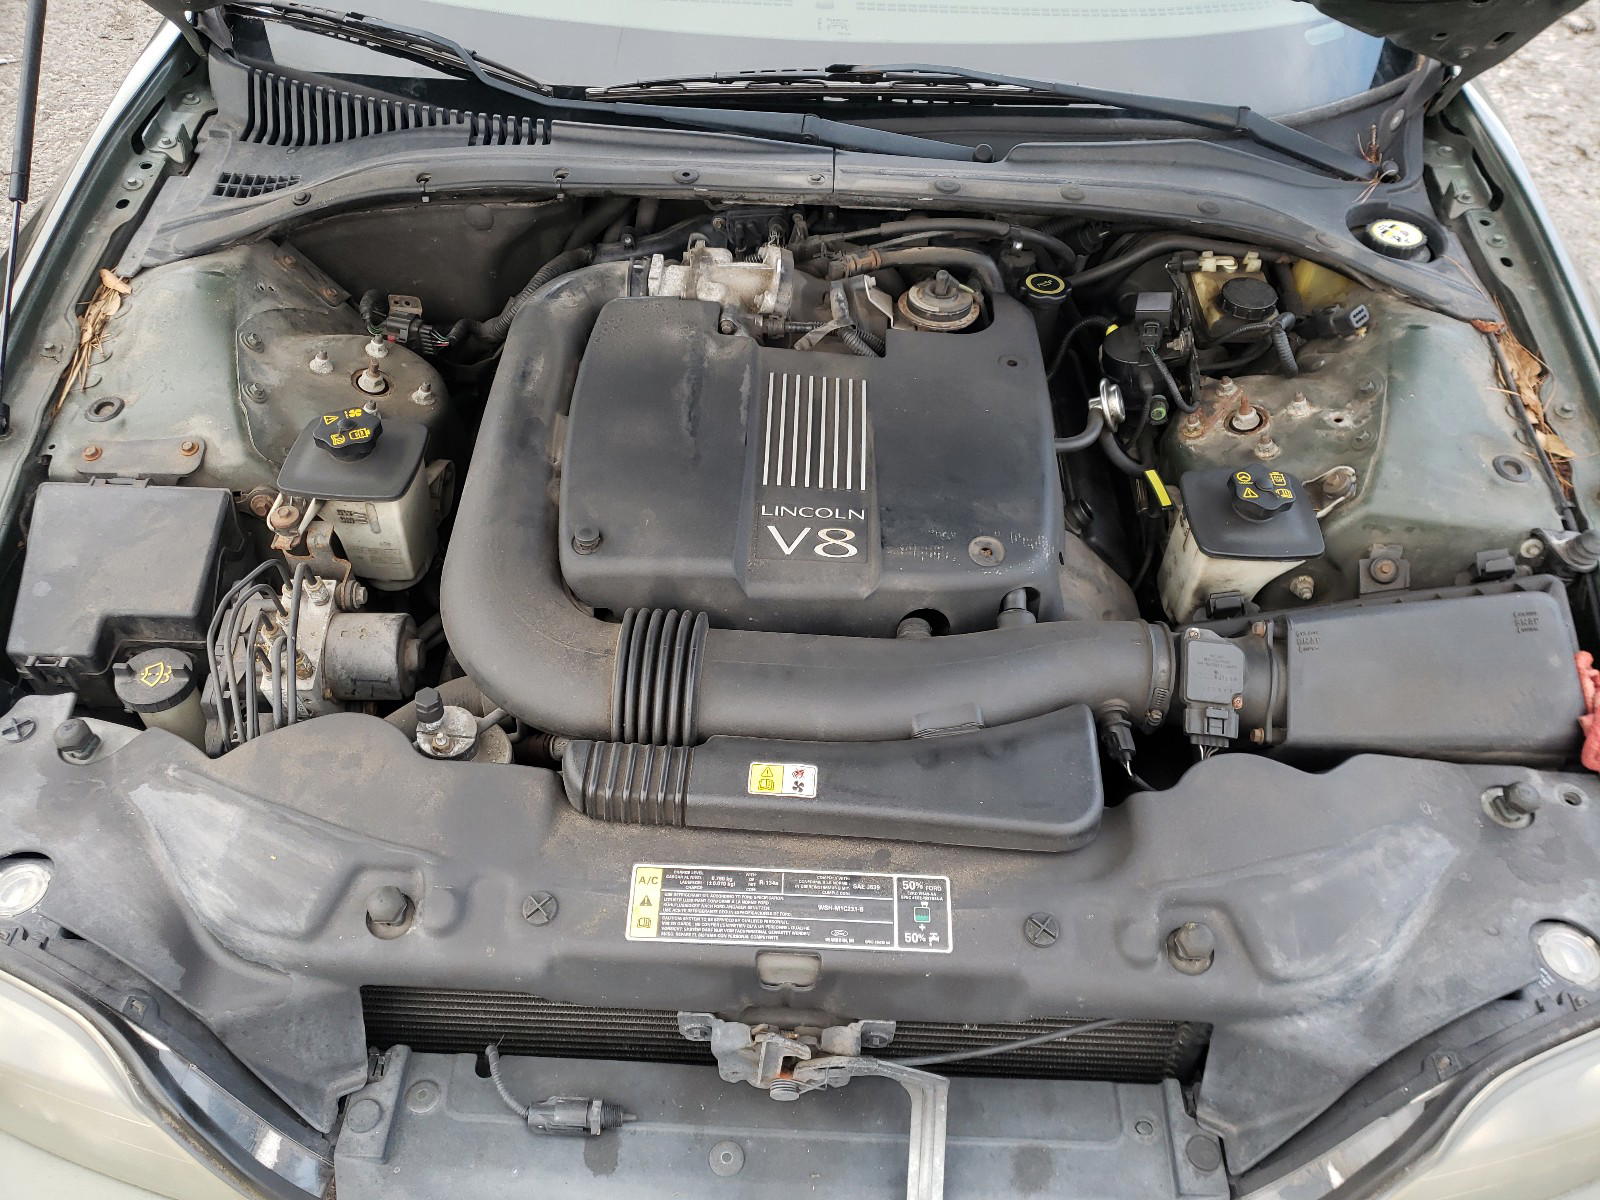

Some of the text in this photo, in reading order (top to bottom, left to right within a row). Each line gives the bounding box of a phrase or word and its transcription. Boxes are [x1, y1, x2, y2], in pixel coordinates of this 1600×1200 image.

[761, 505, 865, 520] LINCOLN
[767, 525, 859, 558] V8
[638, 876, 659, 886] A/C
[902, 880, 924, 891] 50%
[904, 932, 927, 943] 50%
